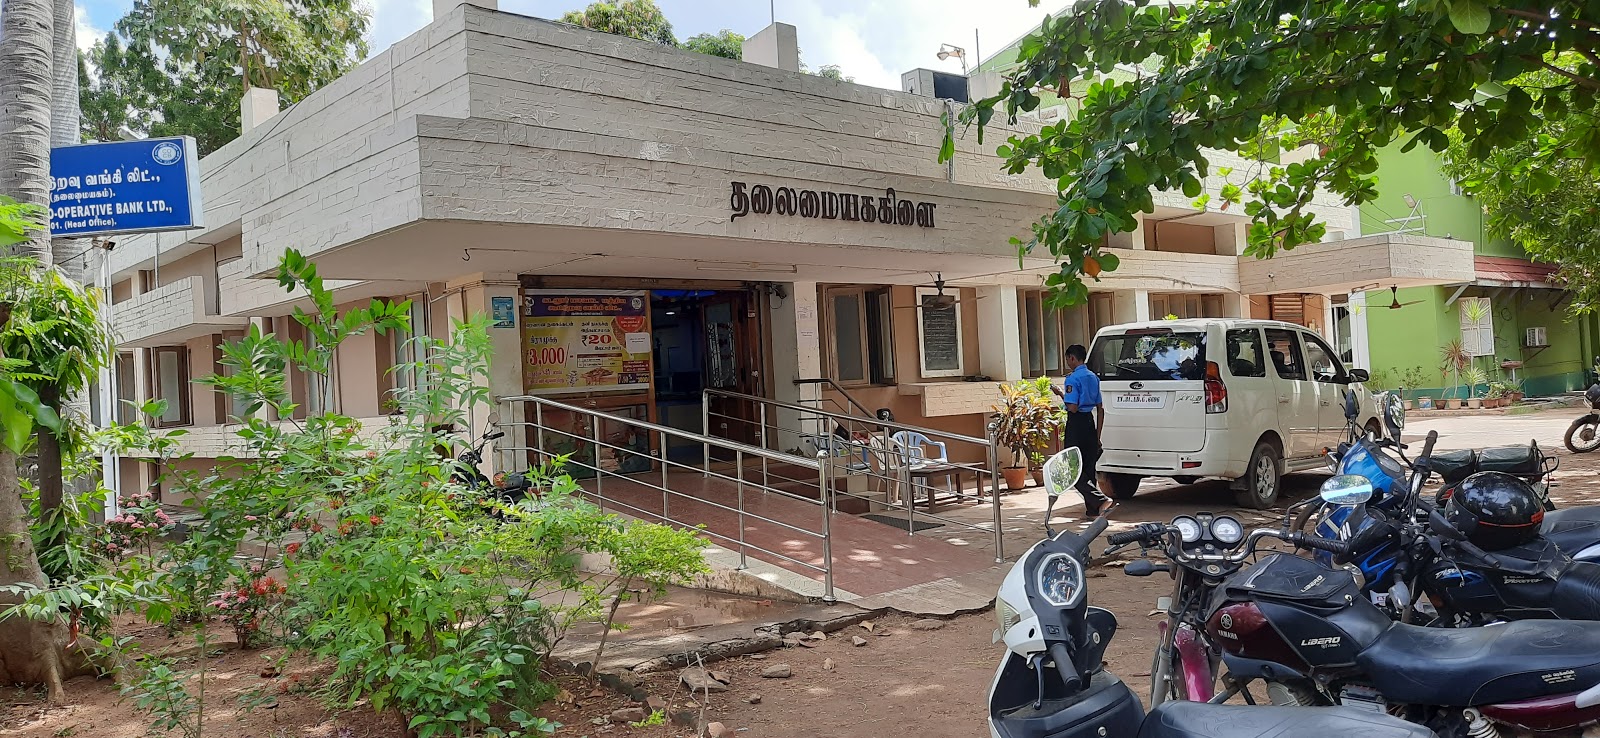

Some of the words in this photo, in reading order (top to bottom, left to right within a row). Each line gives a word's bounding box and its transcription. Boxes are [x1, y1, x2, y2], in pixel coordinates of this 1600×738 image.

[85, 168, 122, 186] வங்கி
[115, 201, 144, 215] BANK
[146, 200, 172, 213] LTD.,
[64, 219, 87, 230] (Head
[88, 217, 117, 227] Office).
[581, 334, 612, 347] ₹20
[1217, 629, 1239, 641] YAMAHA
